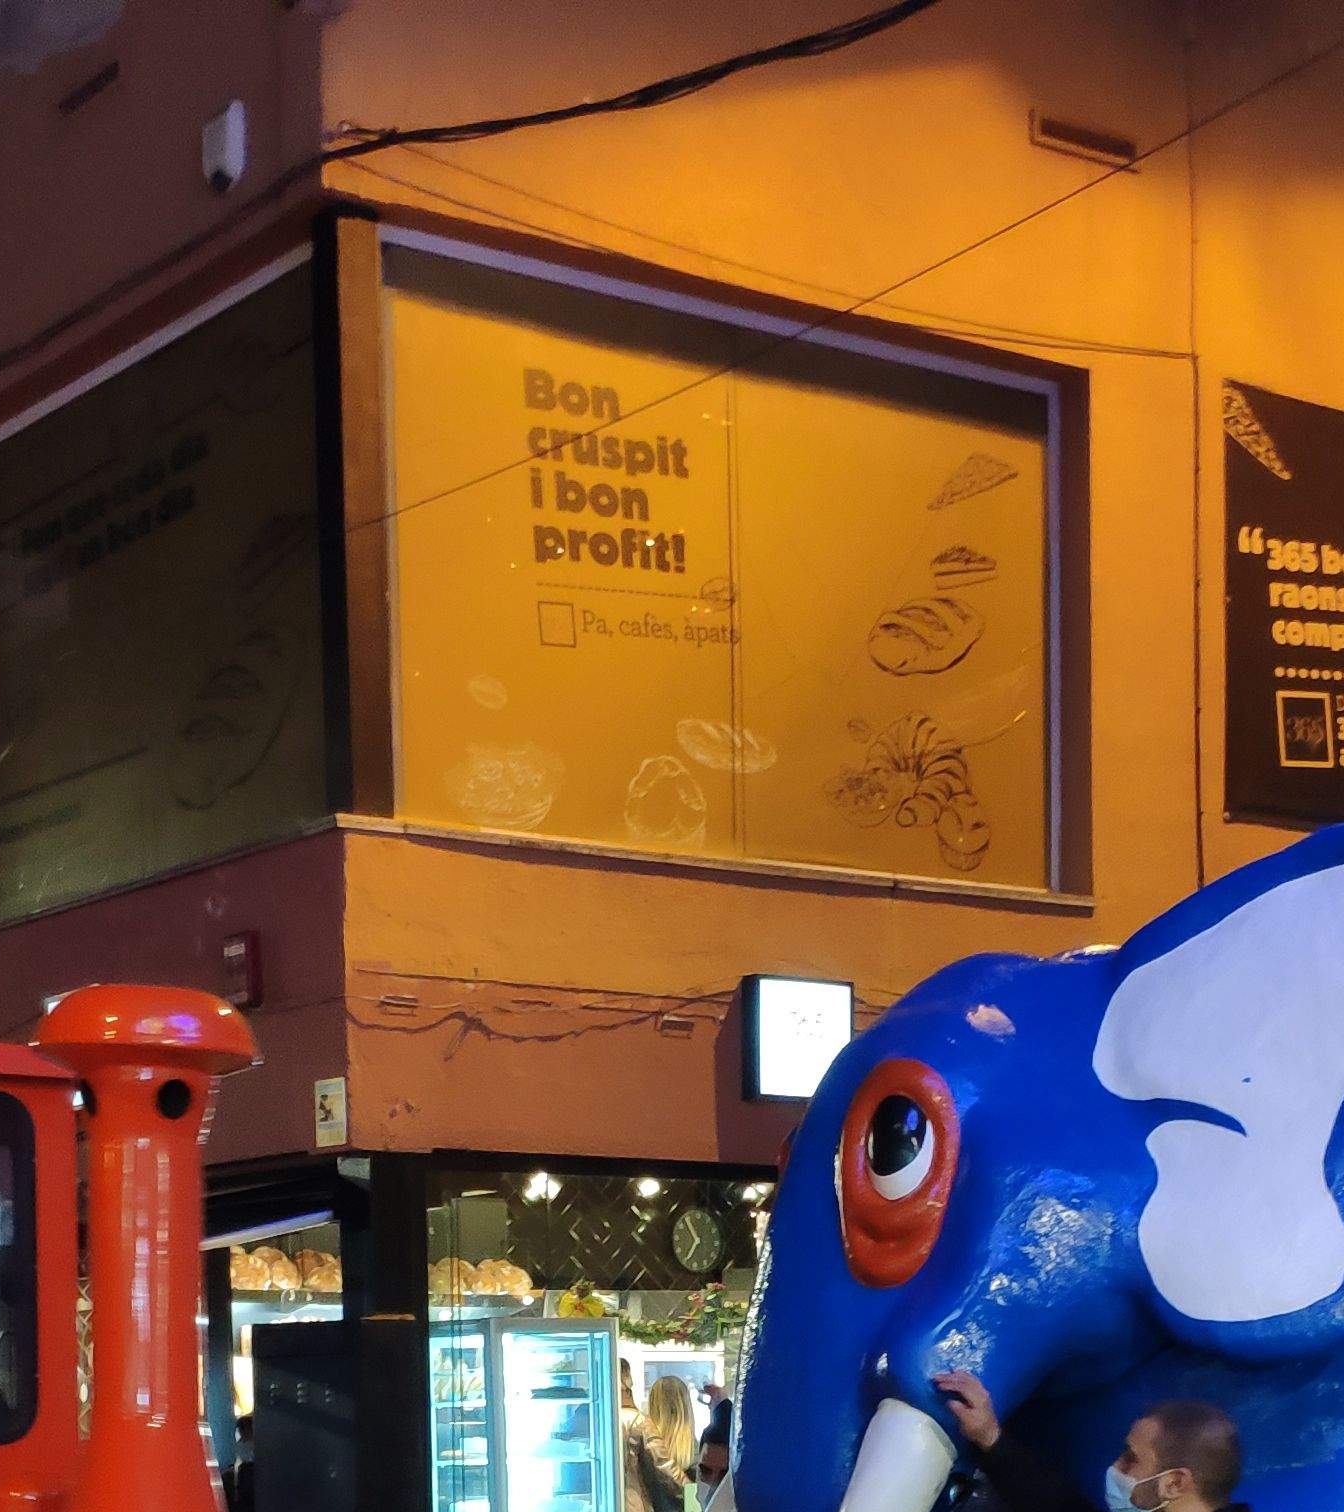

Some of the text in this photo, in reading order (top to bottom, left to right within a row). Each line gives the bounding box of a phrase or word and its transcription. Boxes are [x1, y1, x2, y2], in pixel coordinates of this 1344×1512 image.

[523, 368, 621, 420] Bon
[527, 426, 689, 479] cruspit
[529, 467, 650, 522] i bon
[532, 524, 686, 574] profit!
[581, 609, 613, 637] Pa,
